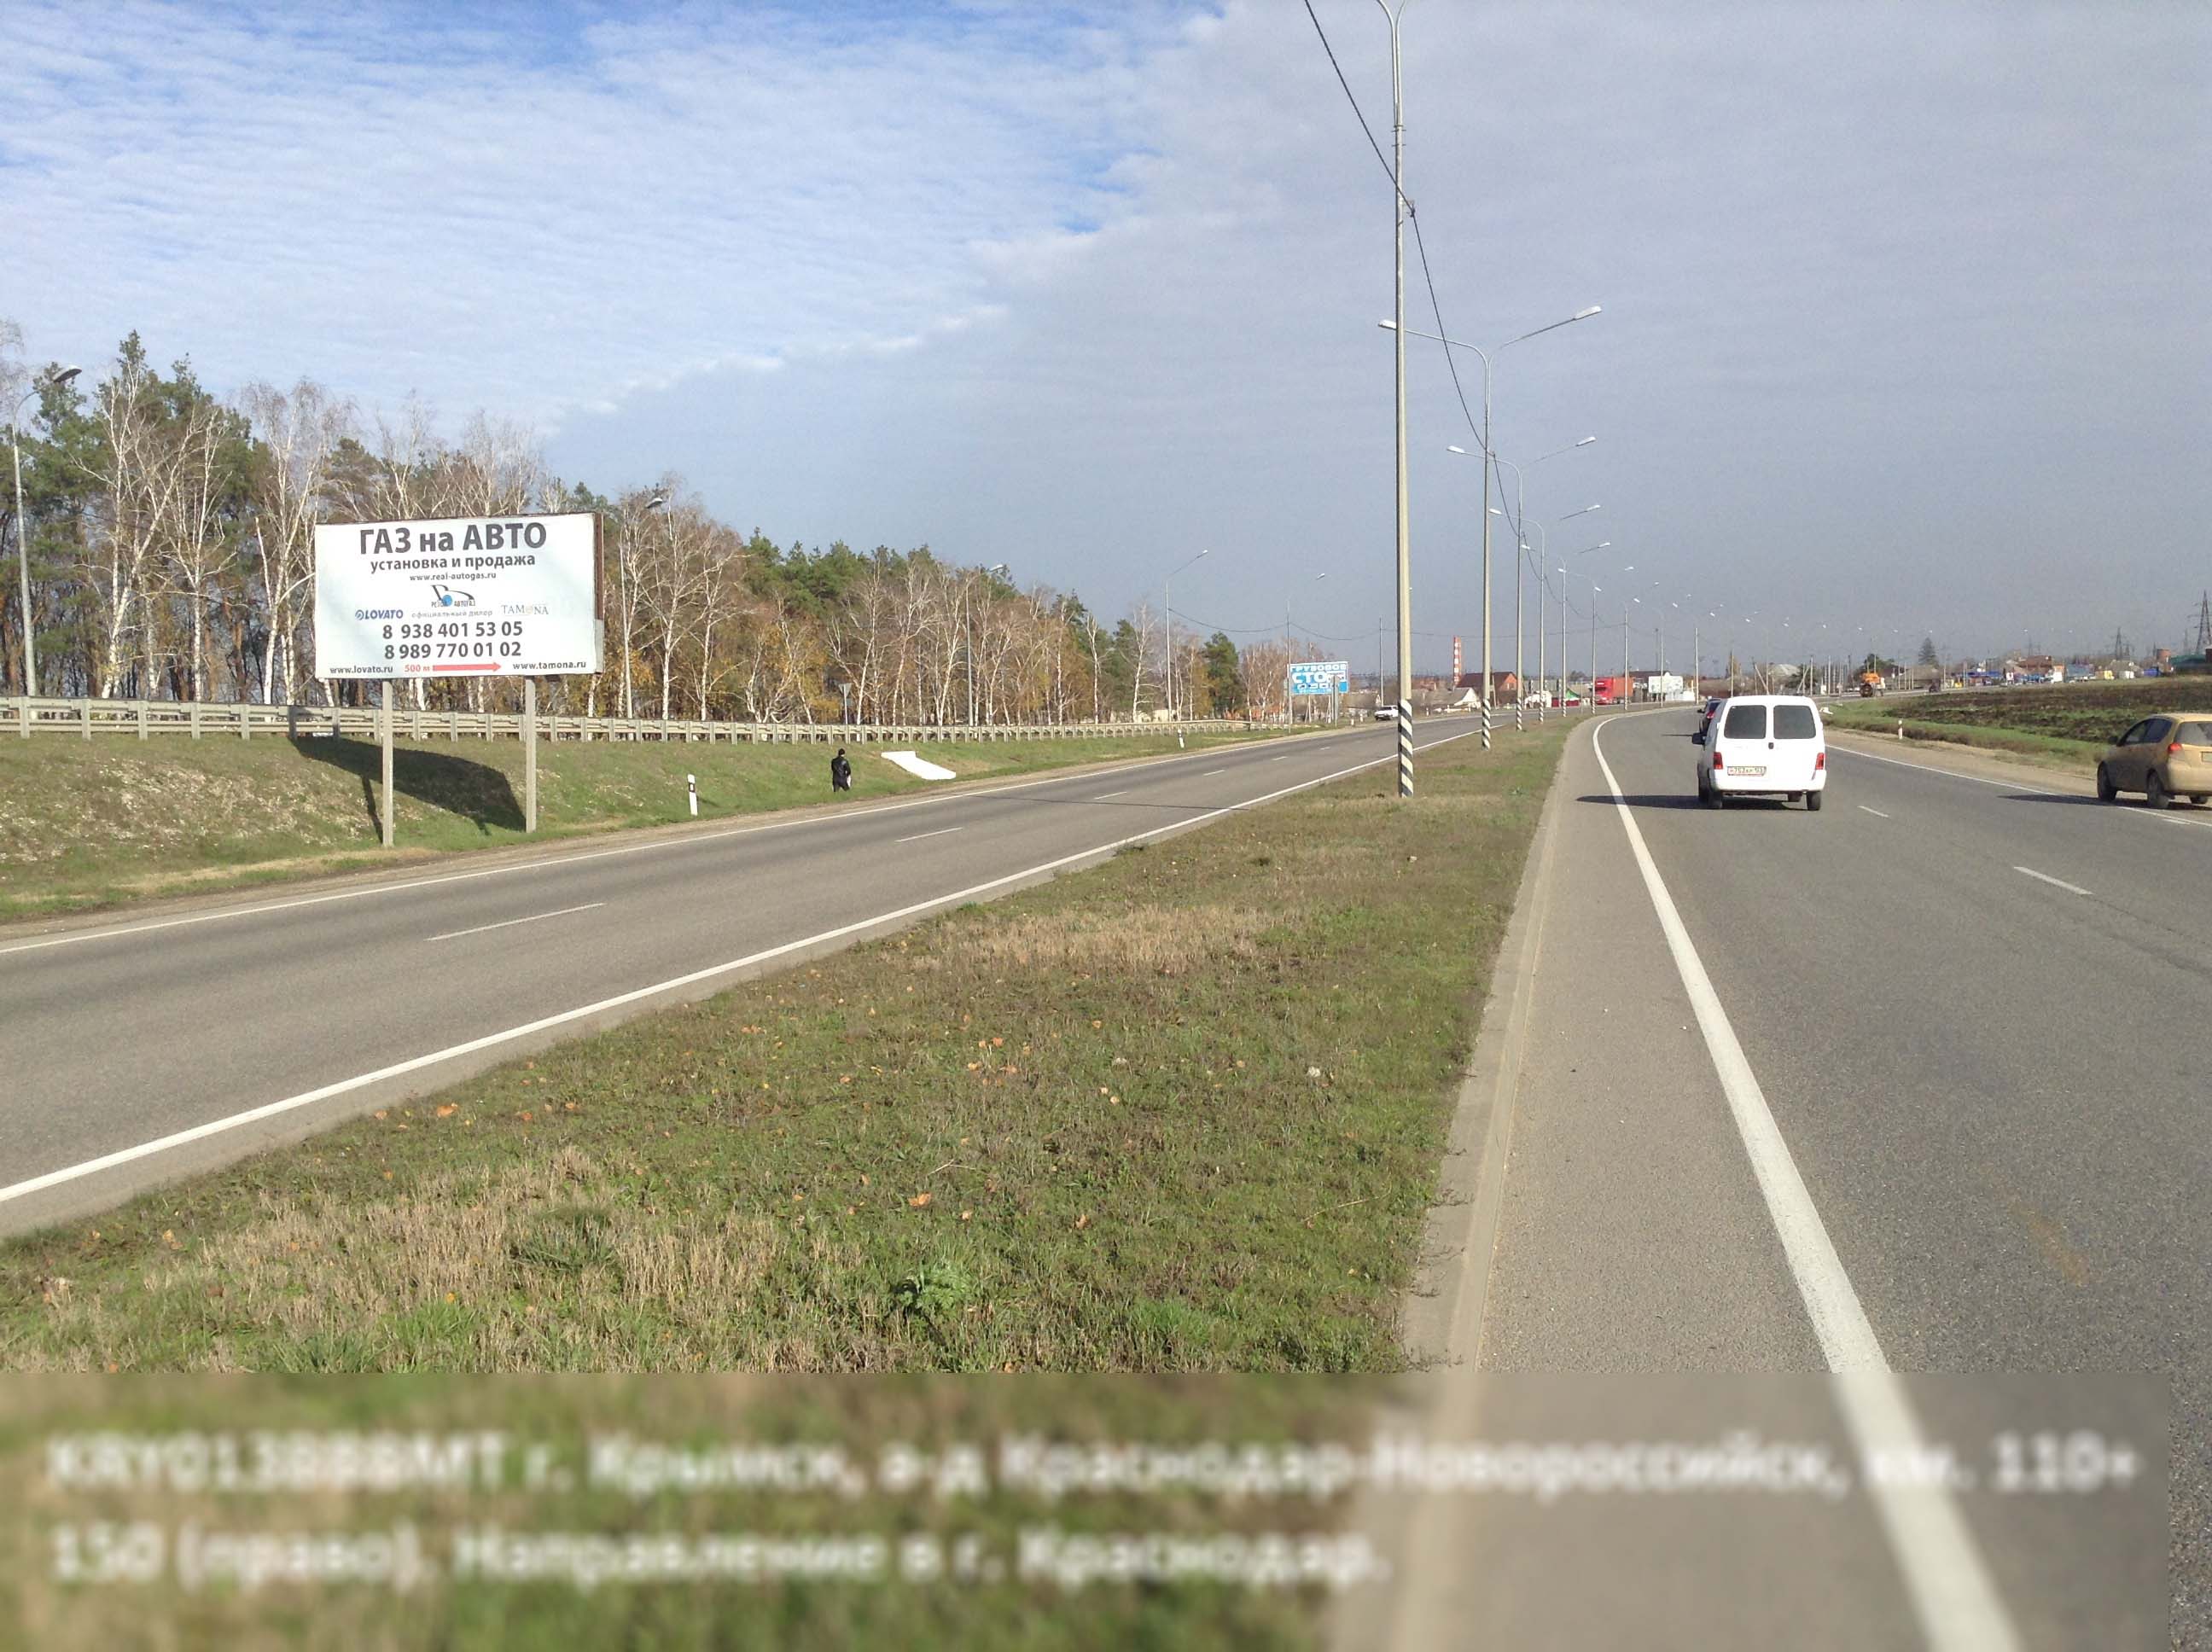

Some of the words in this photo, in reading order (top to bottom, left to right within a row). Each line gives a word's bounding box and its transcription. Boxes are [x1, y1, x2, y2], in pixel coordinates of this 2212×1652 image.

[360, 527, 410, 555] ГАЗ
[420, 532, 453, 552] на
[463, 522, 546, 550] АВТО
[370, 557, 447, 573] установка
[451, 557, 461, 567] и
[465, 555, 535, 570] продажа
[410, 573, 496, 581] www.real-autogas.ru
[364, 609, 403, 620] LOVATO
[382, 625, 393, 639] 8
[401, 624, 433, 638] 938
[438, 623, 468, 637] 401
[476, 622, 496, 637] 53
[502, 621, 522, 636] 05
[384, 644, 394, 659] 8
[399, 643, 431, 659] 989
[436, 643, 468, 657] 770
[474, 642, 492, 657] 01
[500, 642, 521, 656] 02
[330, 665, 393, 673] www.lovato.ru
[405, 664, 421, 672] 500
[513, 660, 586, 670] www.tamona.ru
